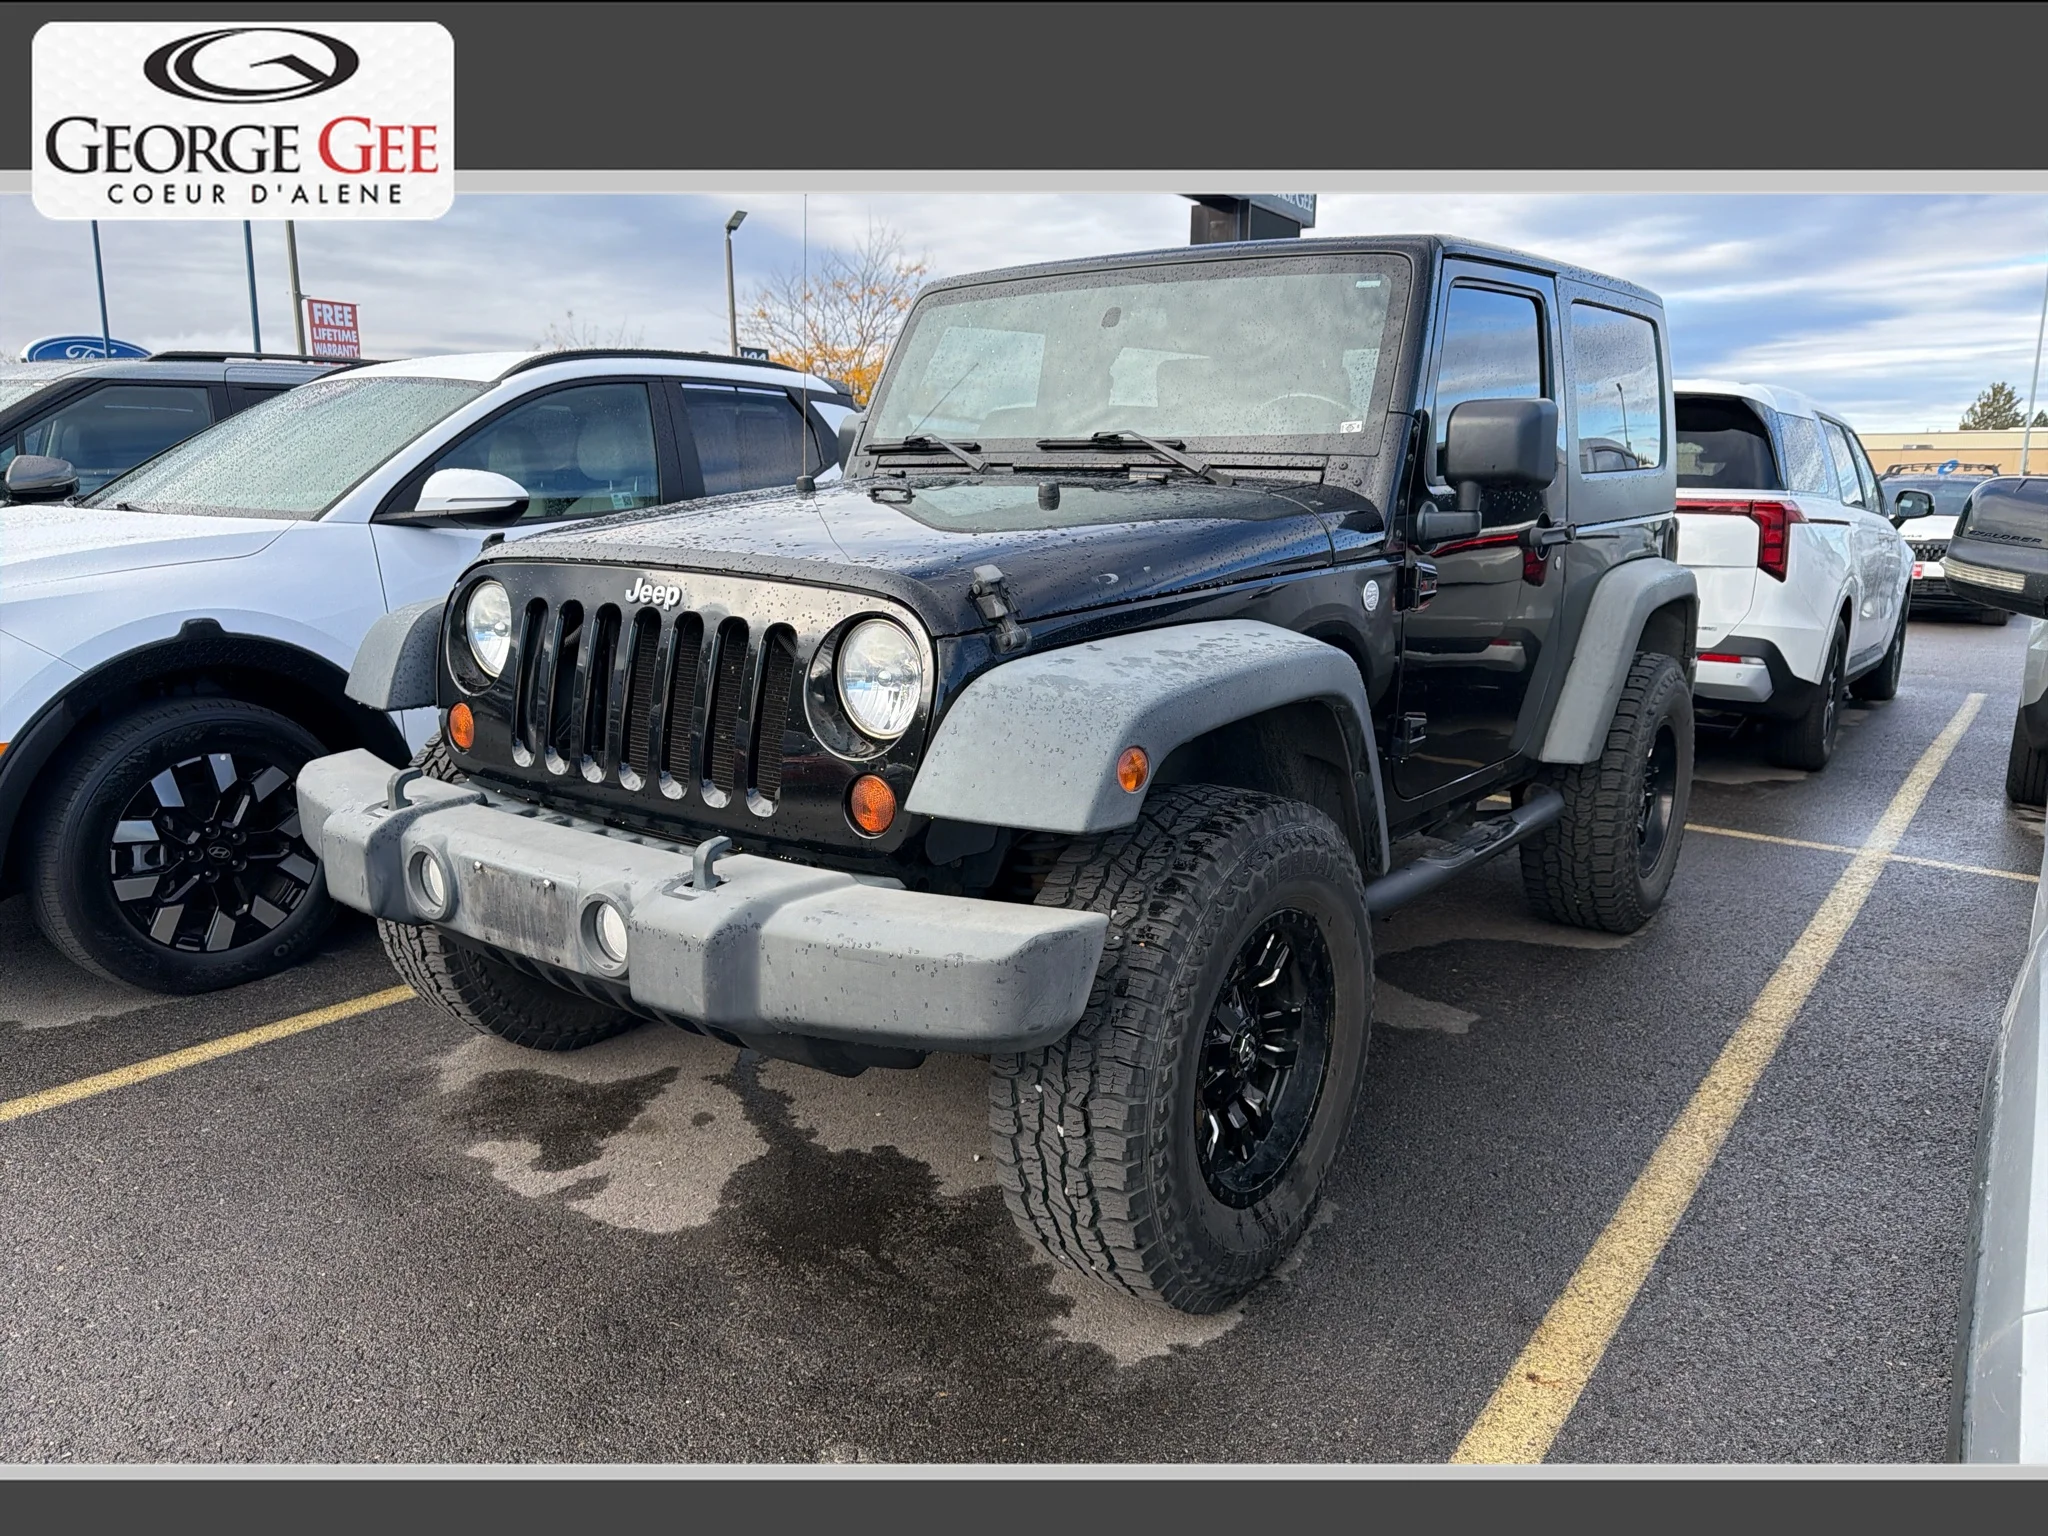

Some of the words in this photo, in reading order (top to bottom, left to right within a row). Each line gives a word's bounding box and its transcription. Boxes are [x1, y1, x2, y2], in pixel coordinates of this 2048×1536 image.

[313, 303, 353, 327] FREE
[313, 327, 358, 342] LIFETIME
[1967, 530, 2043, 543] EXPLORER
[625, 577, 682, 611] Jeep
